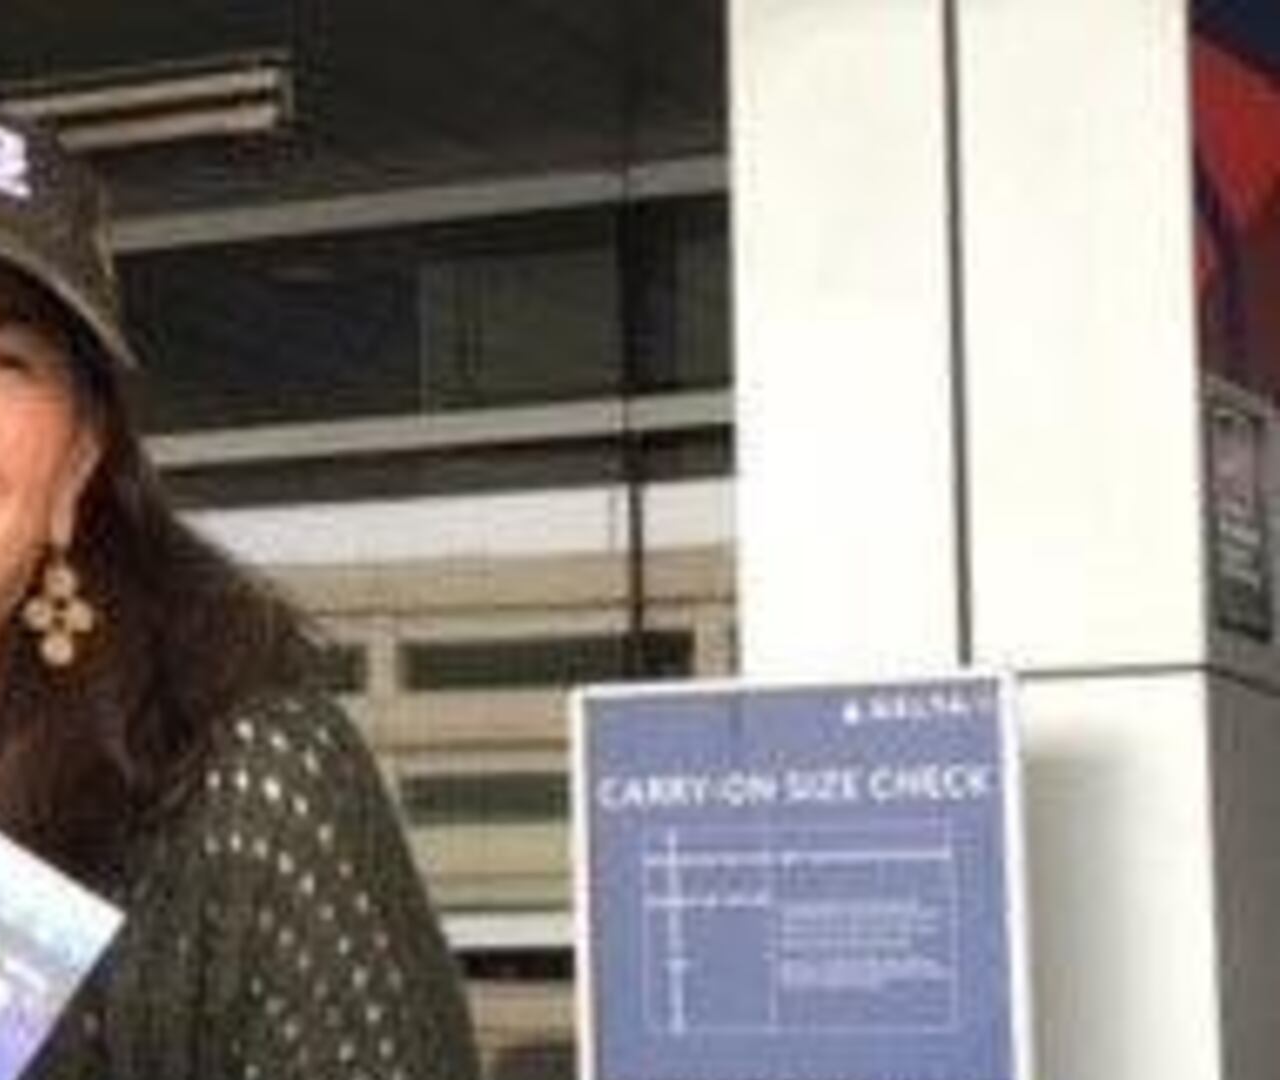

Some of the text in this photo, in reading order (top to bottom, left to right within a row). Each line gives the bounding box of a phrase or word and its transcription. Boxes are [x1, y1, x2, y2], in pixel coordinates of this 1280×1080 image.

[596, 763, 995, 810] CARRY-ON SIZE CHECK
